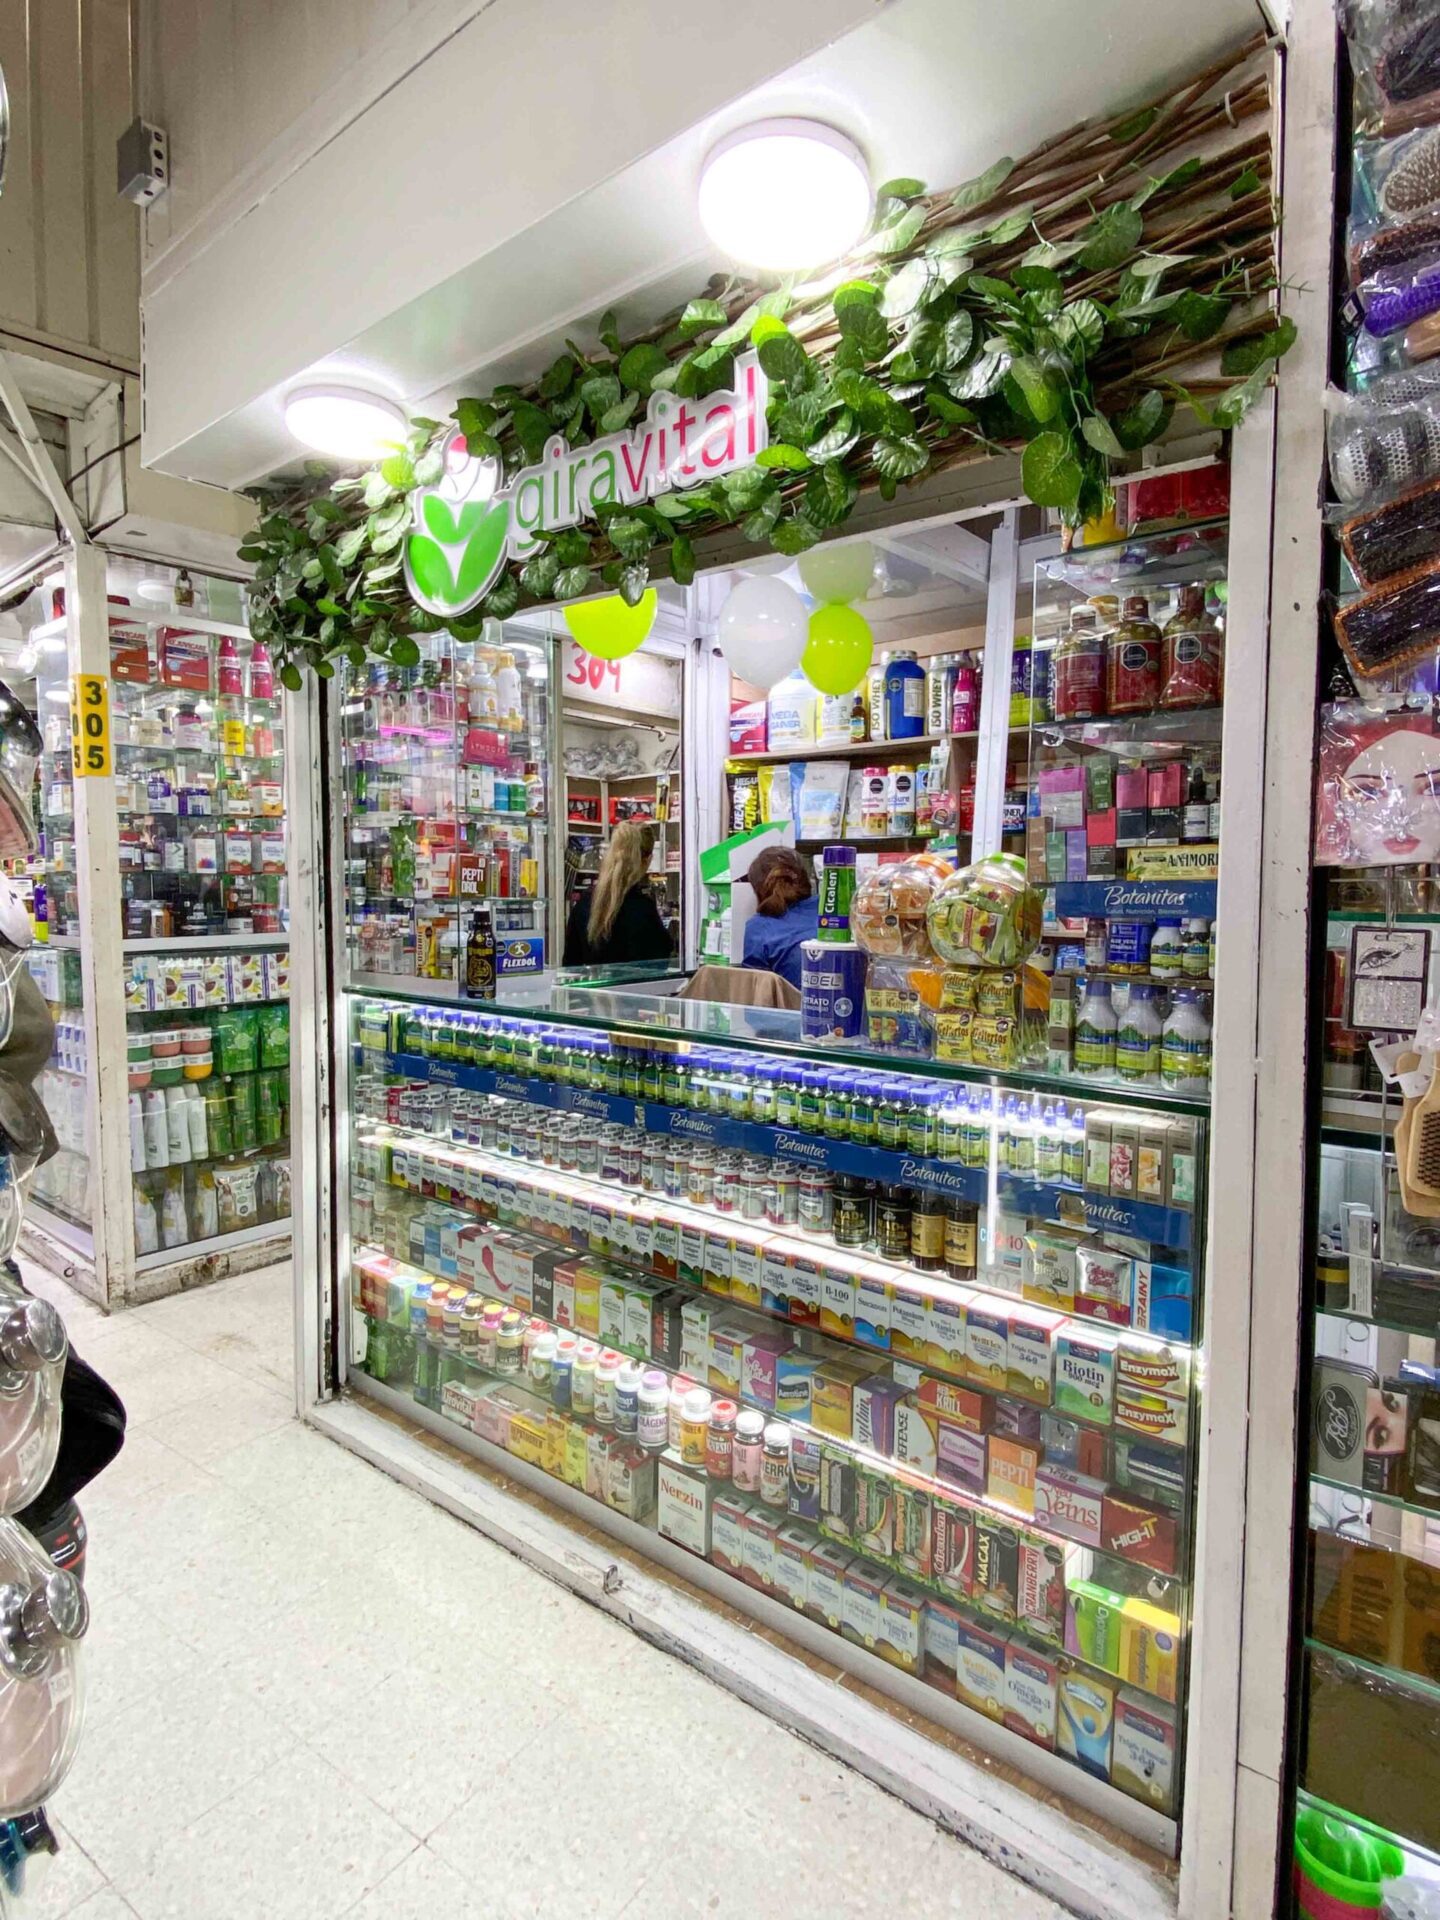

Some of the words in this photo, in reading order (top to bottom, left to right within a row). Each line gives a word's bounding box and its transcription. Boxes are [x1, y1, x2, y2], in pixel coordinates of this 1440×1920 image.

[516, 367, 756, 550] giravital
[872, 678, 882, 709] WHEY
[932, 678, 943, 706] WHEY
[86, 681, 104, 769] 305
[872, 711, 881, 731] ISO
[931, 709, 942, 728] ISO
[462, 867, 484, 882] PEPTI
[825, 871, 838, 913] Cicalen
[1104, 885, 1187, 907] Botanitas
[502, 957, 537, 968] FLEXDOL
[669, 1111, 714, 1135] Botanitas
[775, 1133, 826, 1159] Botanitas
[900, 1159, 963, 1190] Botanitas
[654, 1231, 676, 1245] Alive!
[825, 1285, 849, 1300] B-100
[1137, 1270, 1149, 1329] BRAINY
[930, 1320, 957, 1336] Vitamin
[957, 1328, 962, 1336] C
[1063, 1359, 1105, 1384] Biotin
[1084, 1378, 1101, 1389] mcg
[991, 1457, 1029, 1488] PEPTI
[660, 1477, 703, 1511] Nerzin
[977, 1534, 991, 1586] MACAX
[1025, 1547, 1040, 1617] CRANBERRY
[1008, 1682, 1052, 1710] Omega-3
